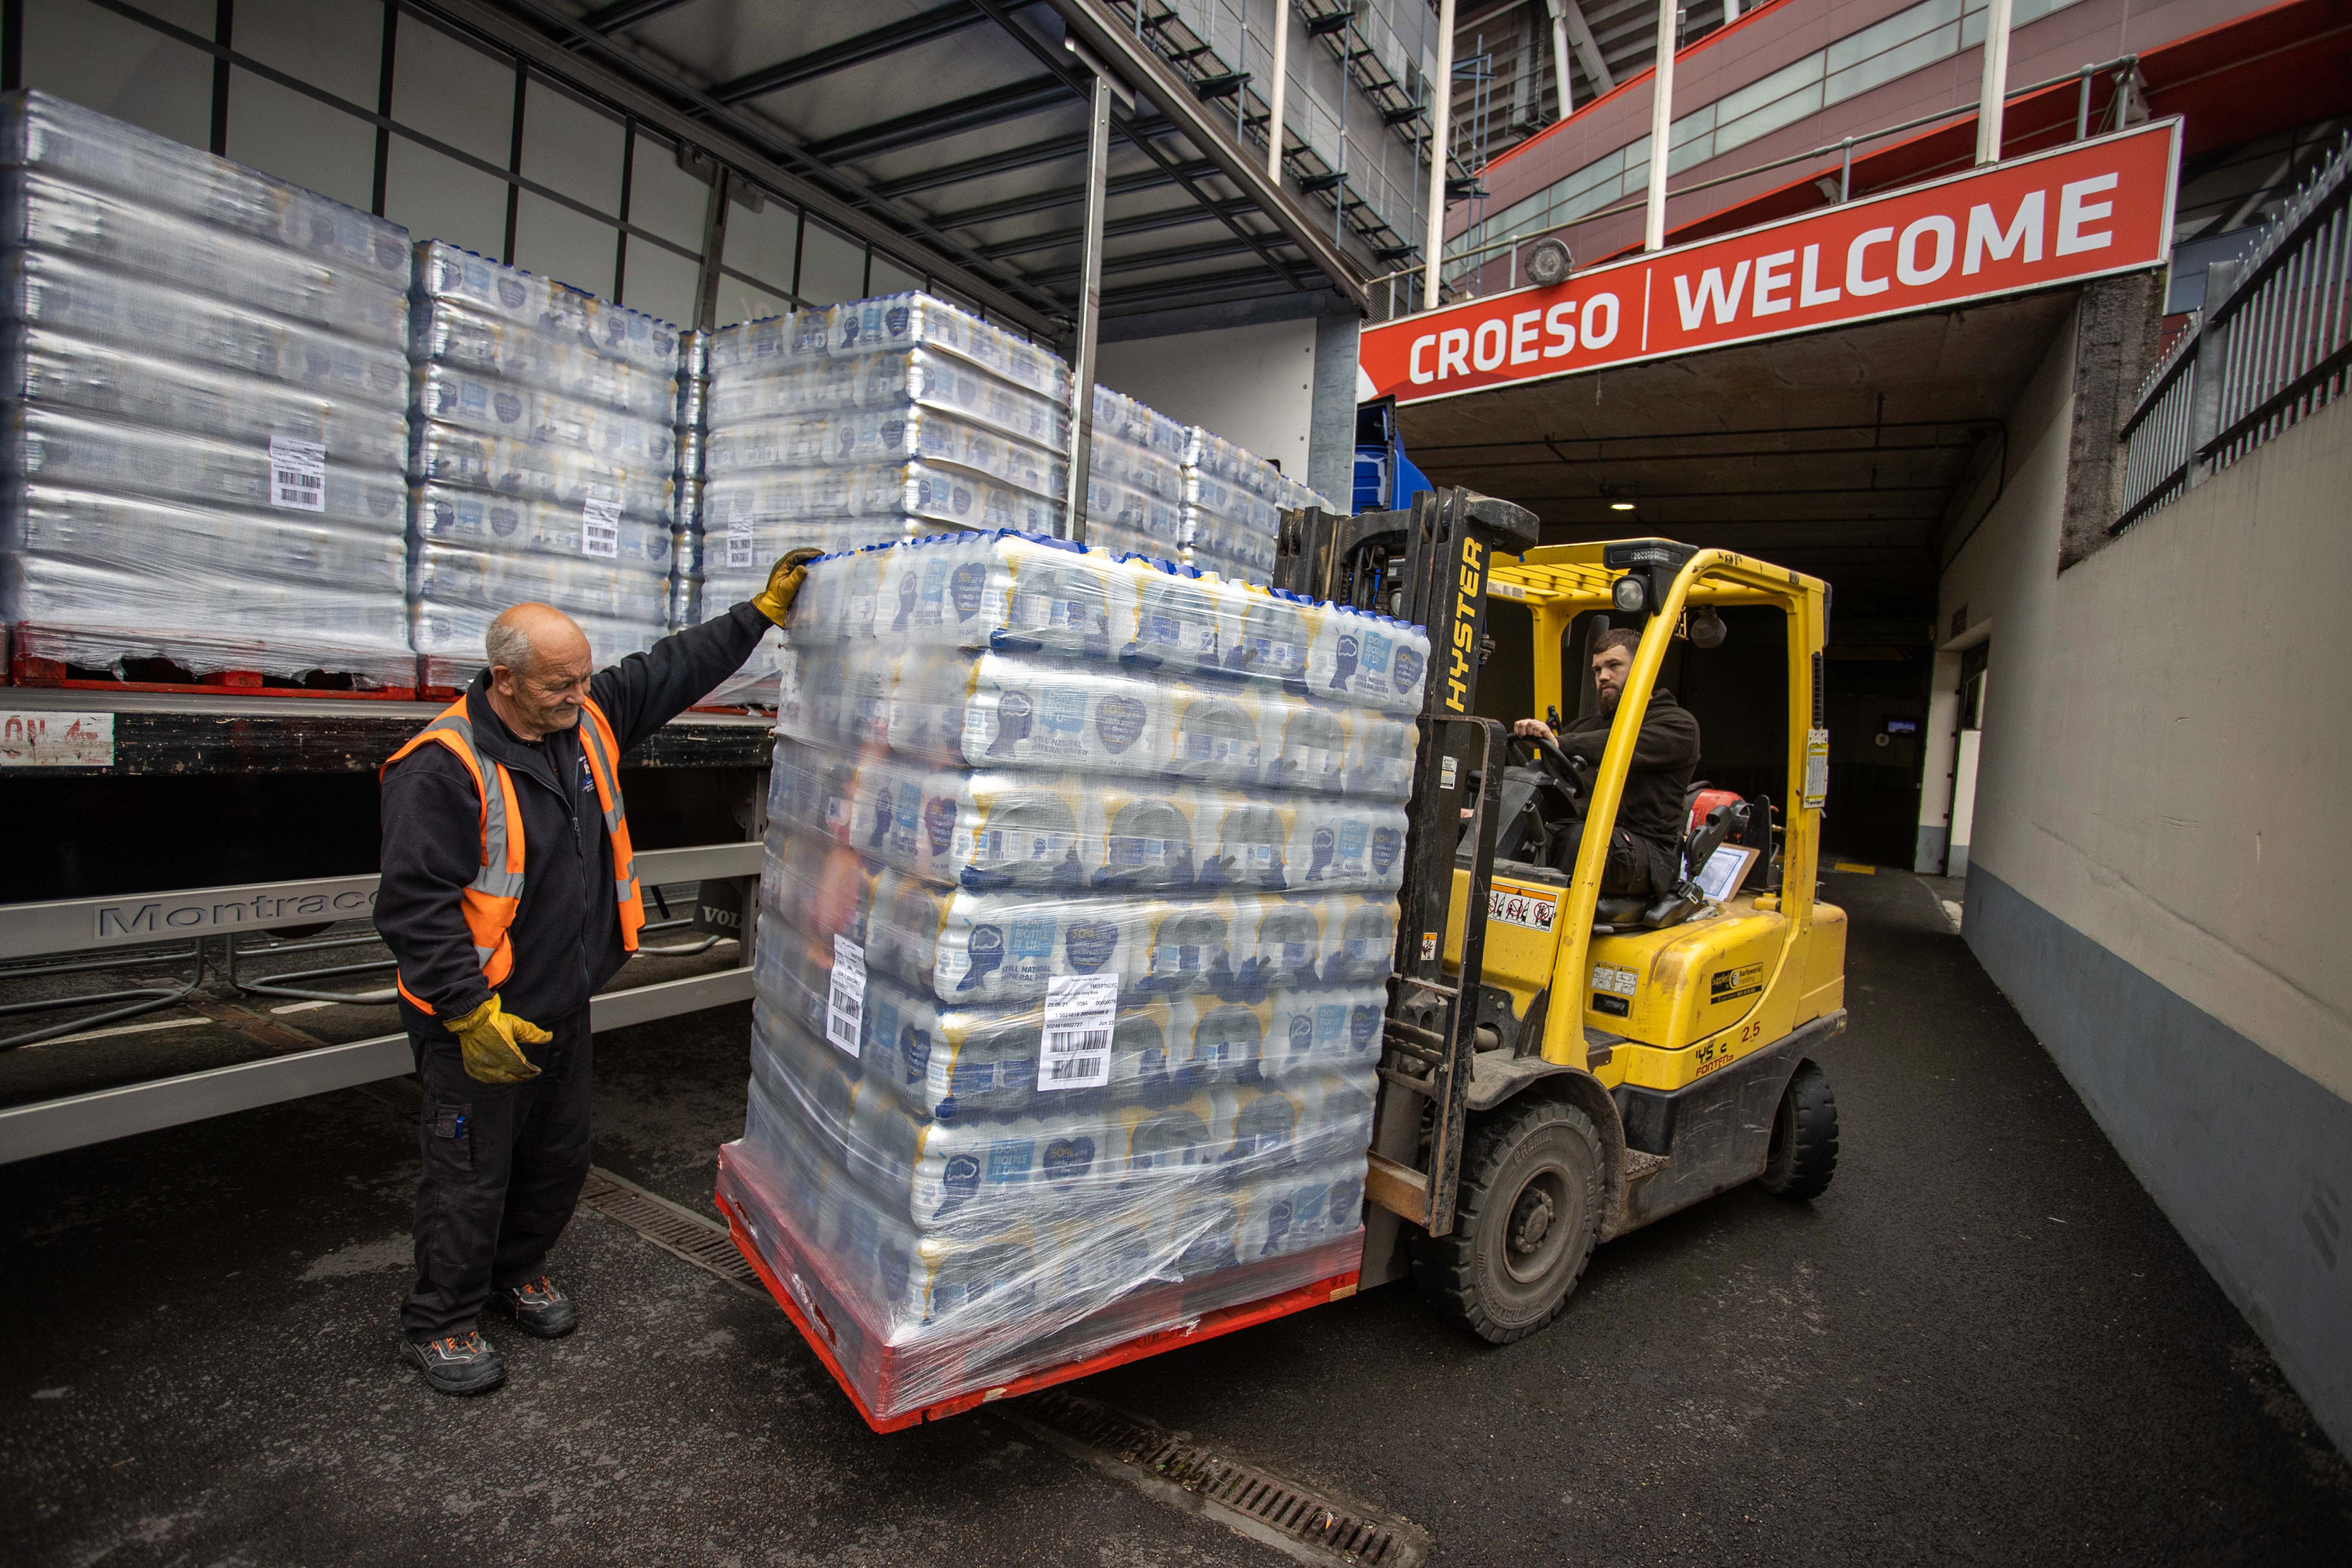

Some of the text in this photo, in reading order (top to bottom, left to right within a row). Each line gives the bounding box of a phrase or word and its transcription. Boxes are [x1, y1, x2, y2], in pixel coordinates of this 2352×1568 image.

[1673, 172, 2119, 331] WELCOME
[1410, 292, 1619, 385] CROESO
[1445, 536, 1482, 713] HYSTER
[1051, 738, 1083, 748] NATURAL
[1016, 928, 1050, 940] BOTTLE
[1073, 929, 1095, 939] 50%
[1002, 964, 1052, 974] STILL NATURAL
[1001, 973, 1033, 981] MINERAL
[1741, 1021, 1760, 1043] 2.5
[1050, 1147, 1073, 1158] 50%
[994, 1155, 1028, 1165] BOTTLE
